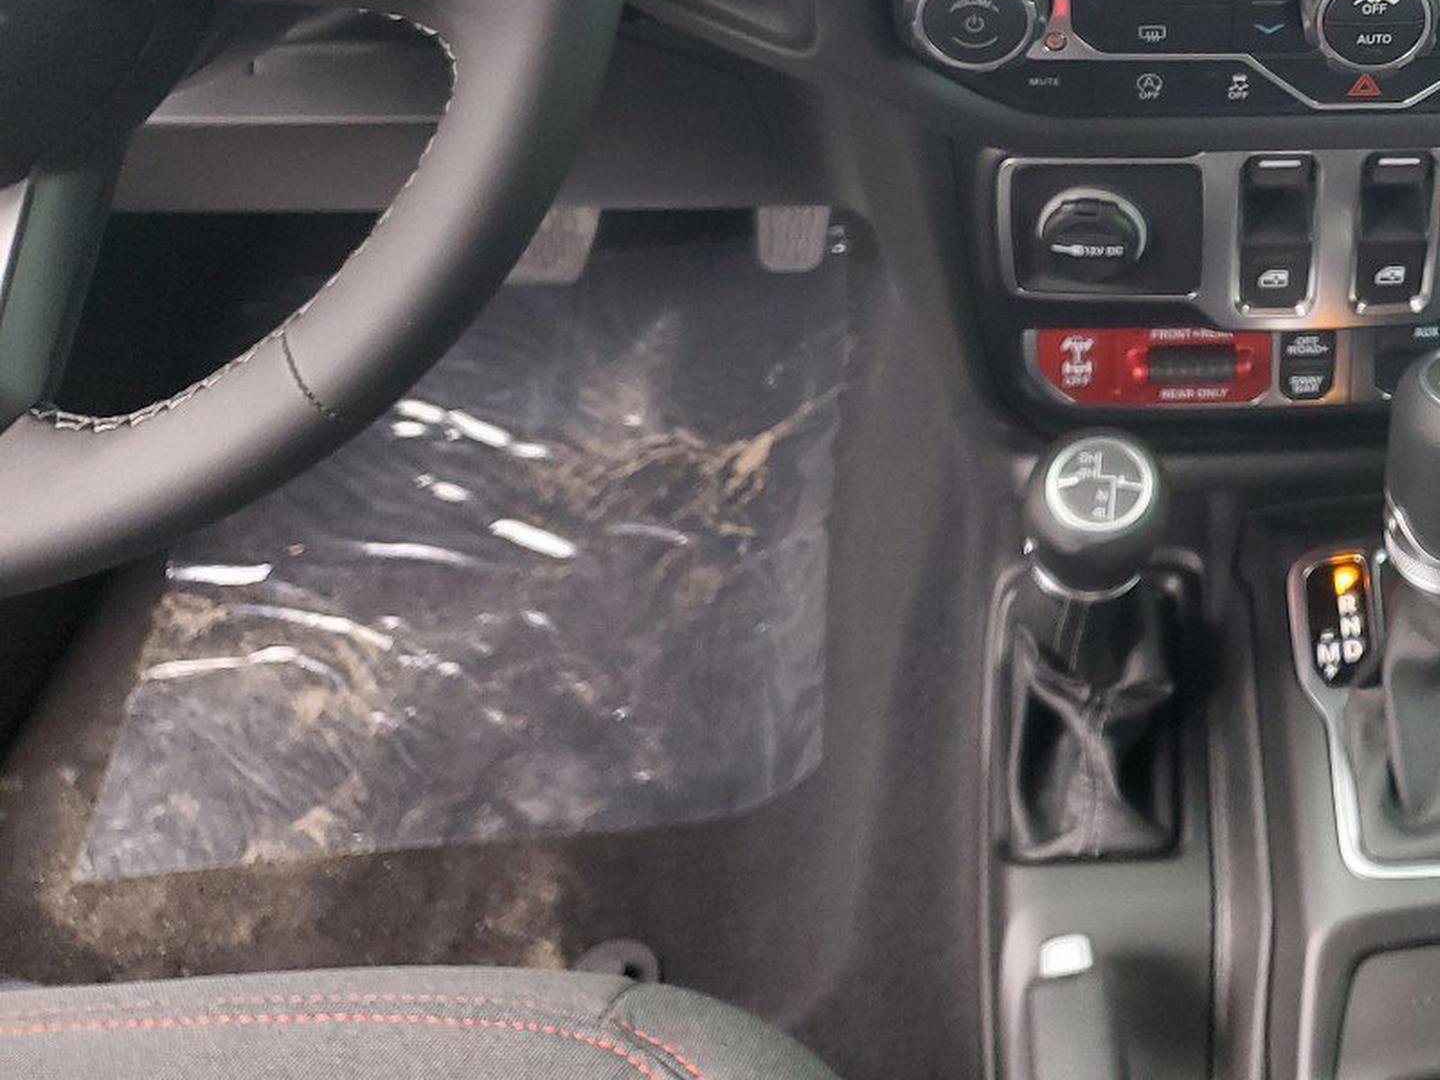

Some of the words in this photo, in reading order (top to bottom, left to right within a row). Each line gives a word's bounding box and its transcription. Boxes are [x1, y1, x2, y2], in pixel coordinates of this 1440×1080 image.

[1362, 2, 1387, 15] OFF
[1356, 33, 1392, 45] AUTO
[1029, 77, 1061, 86] MUTE
[1138, 89, 1160, 100] OFF
[1228, 90, 1249, 100] OFF
[1159, 388, 1196, 399] REAR
[1198, 387, 1229, 398] ONLY
[1338, 594, 1358, 616] R
[1340, 616, 1362, 639] N
[1316, 642, 1341, 668] M
[1342, 638, 1364, 664] D
